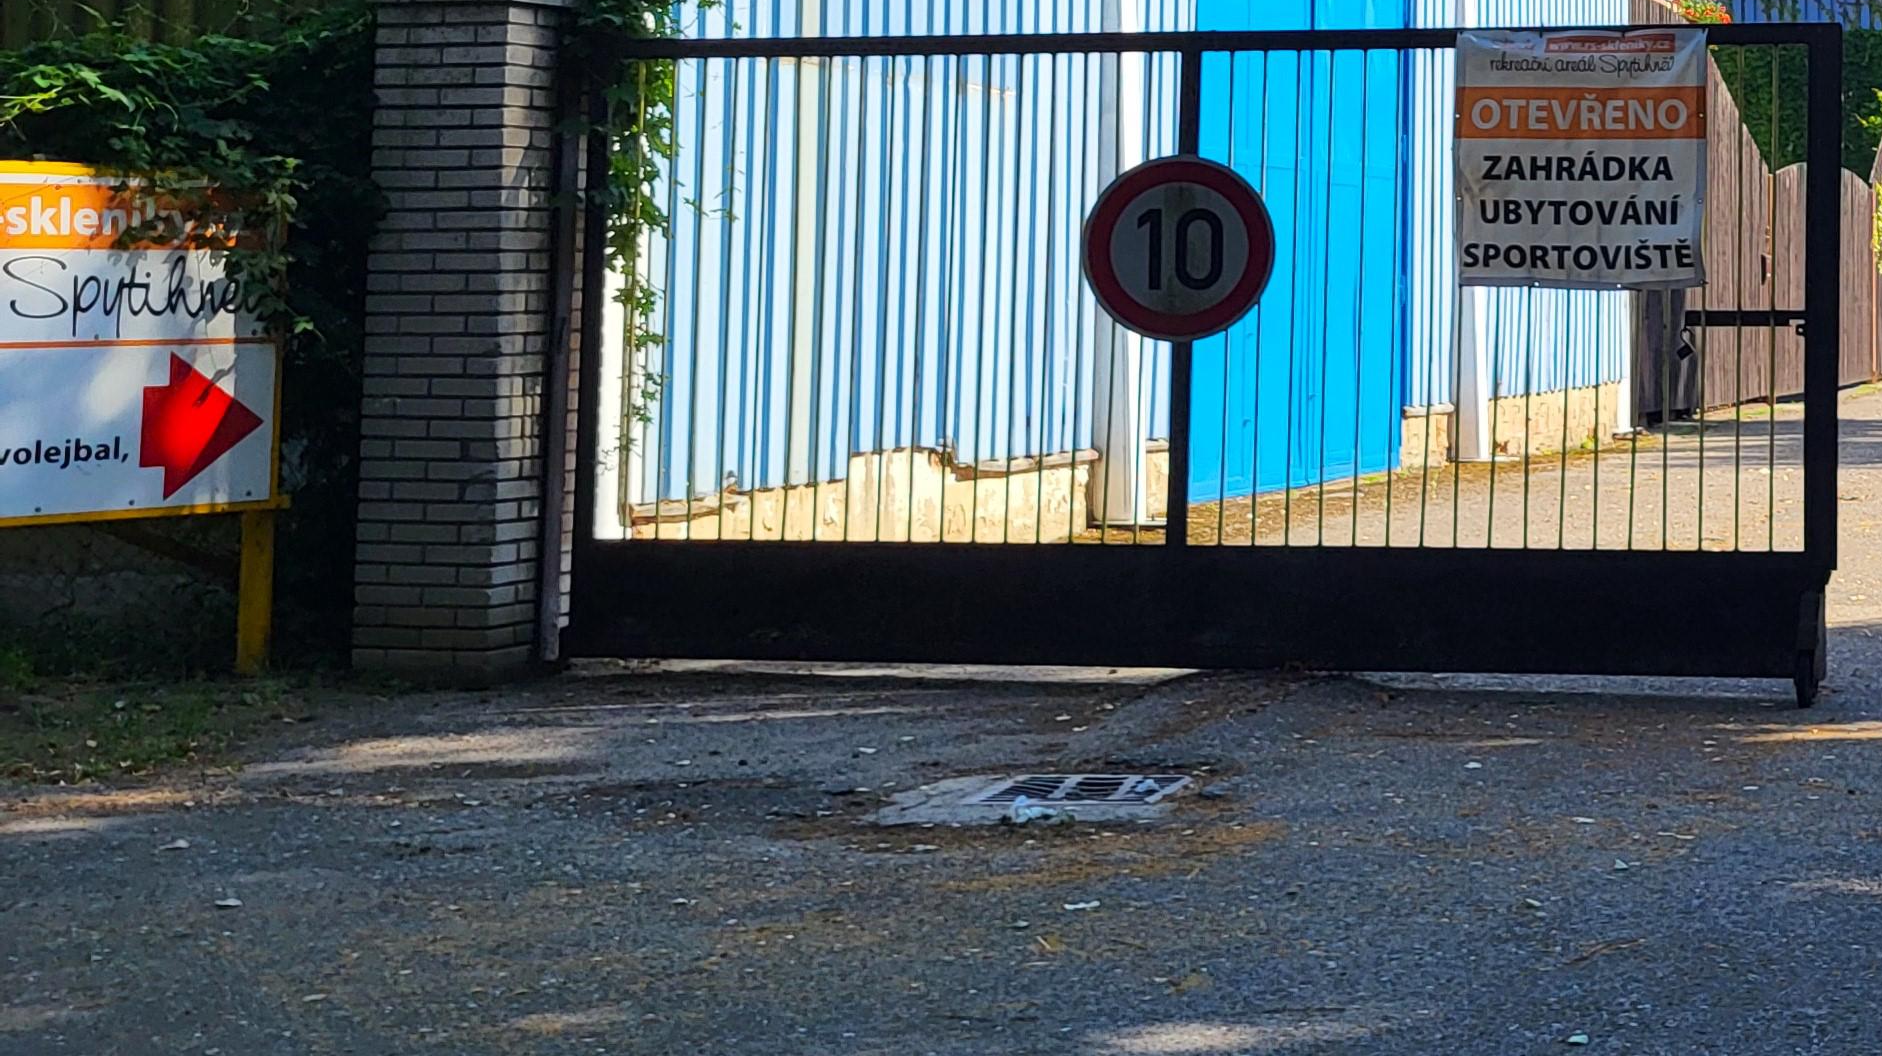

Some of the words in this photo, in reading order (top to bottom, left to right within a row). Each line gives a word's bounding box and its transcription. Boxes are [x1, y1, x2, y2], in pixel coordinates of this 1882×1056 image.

[1555, 54, 1596, 72] areál
[1471, 93, 1688, 130] OTEVŘENO
[1481, 150, 1674, 182] ZAHRÁDKA
[1480, 195, 1681, 226] UBYTOVÁNÍ
[1137, 208, 1224, 291] 10
[1463, 238, 1695, 270] SPORTOVIŠTĚ
[0, 436, 129, 469] volejbal,
